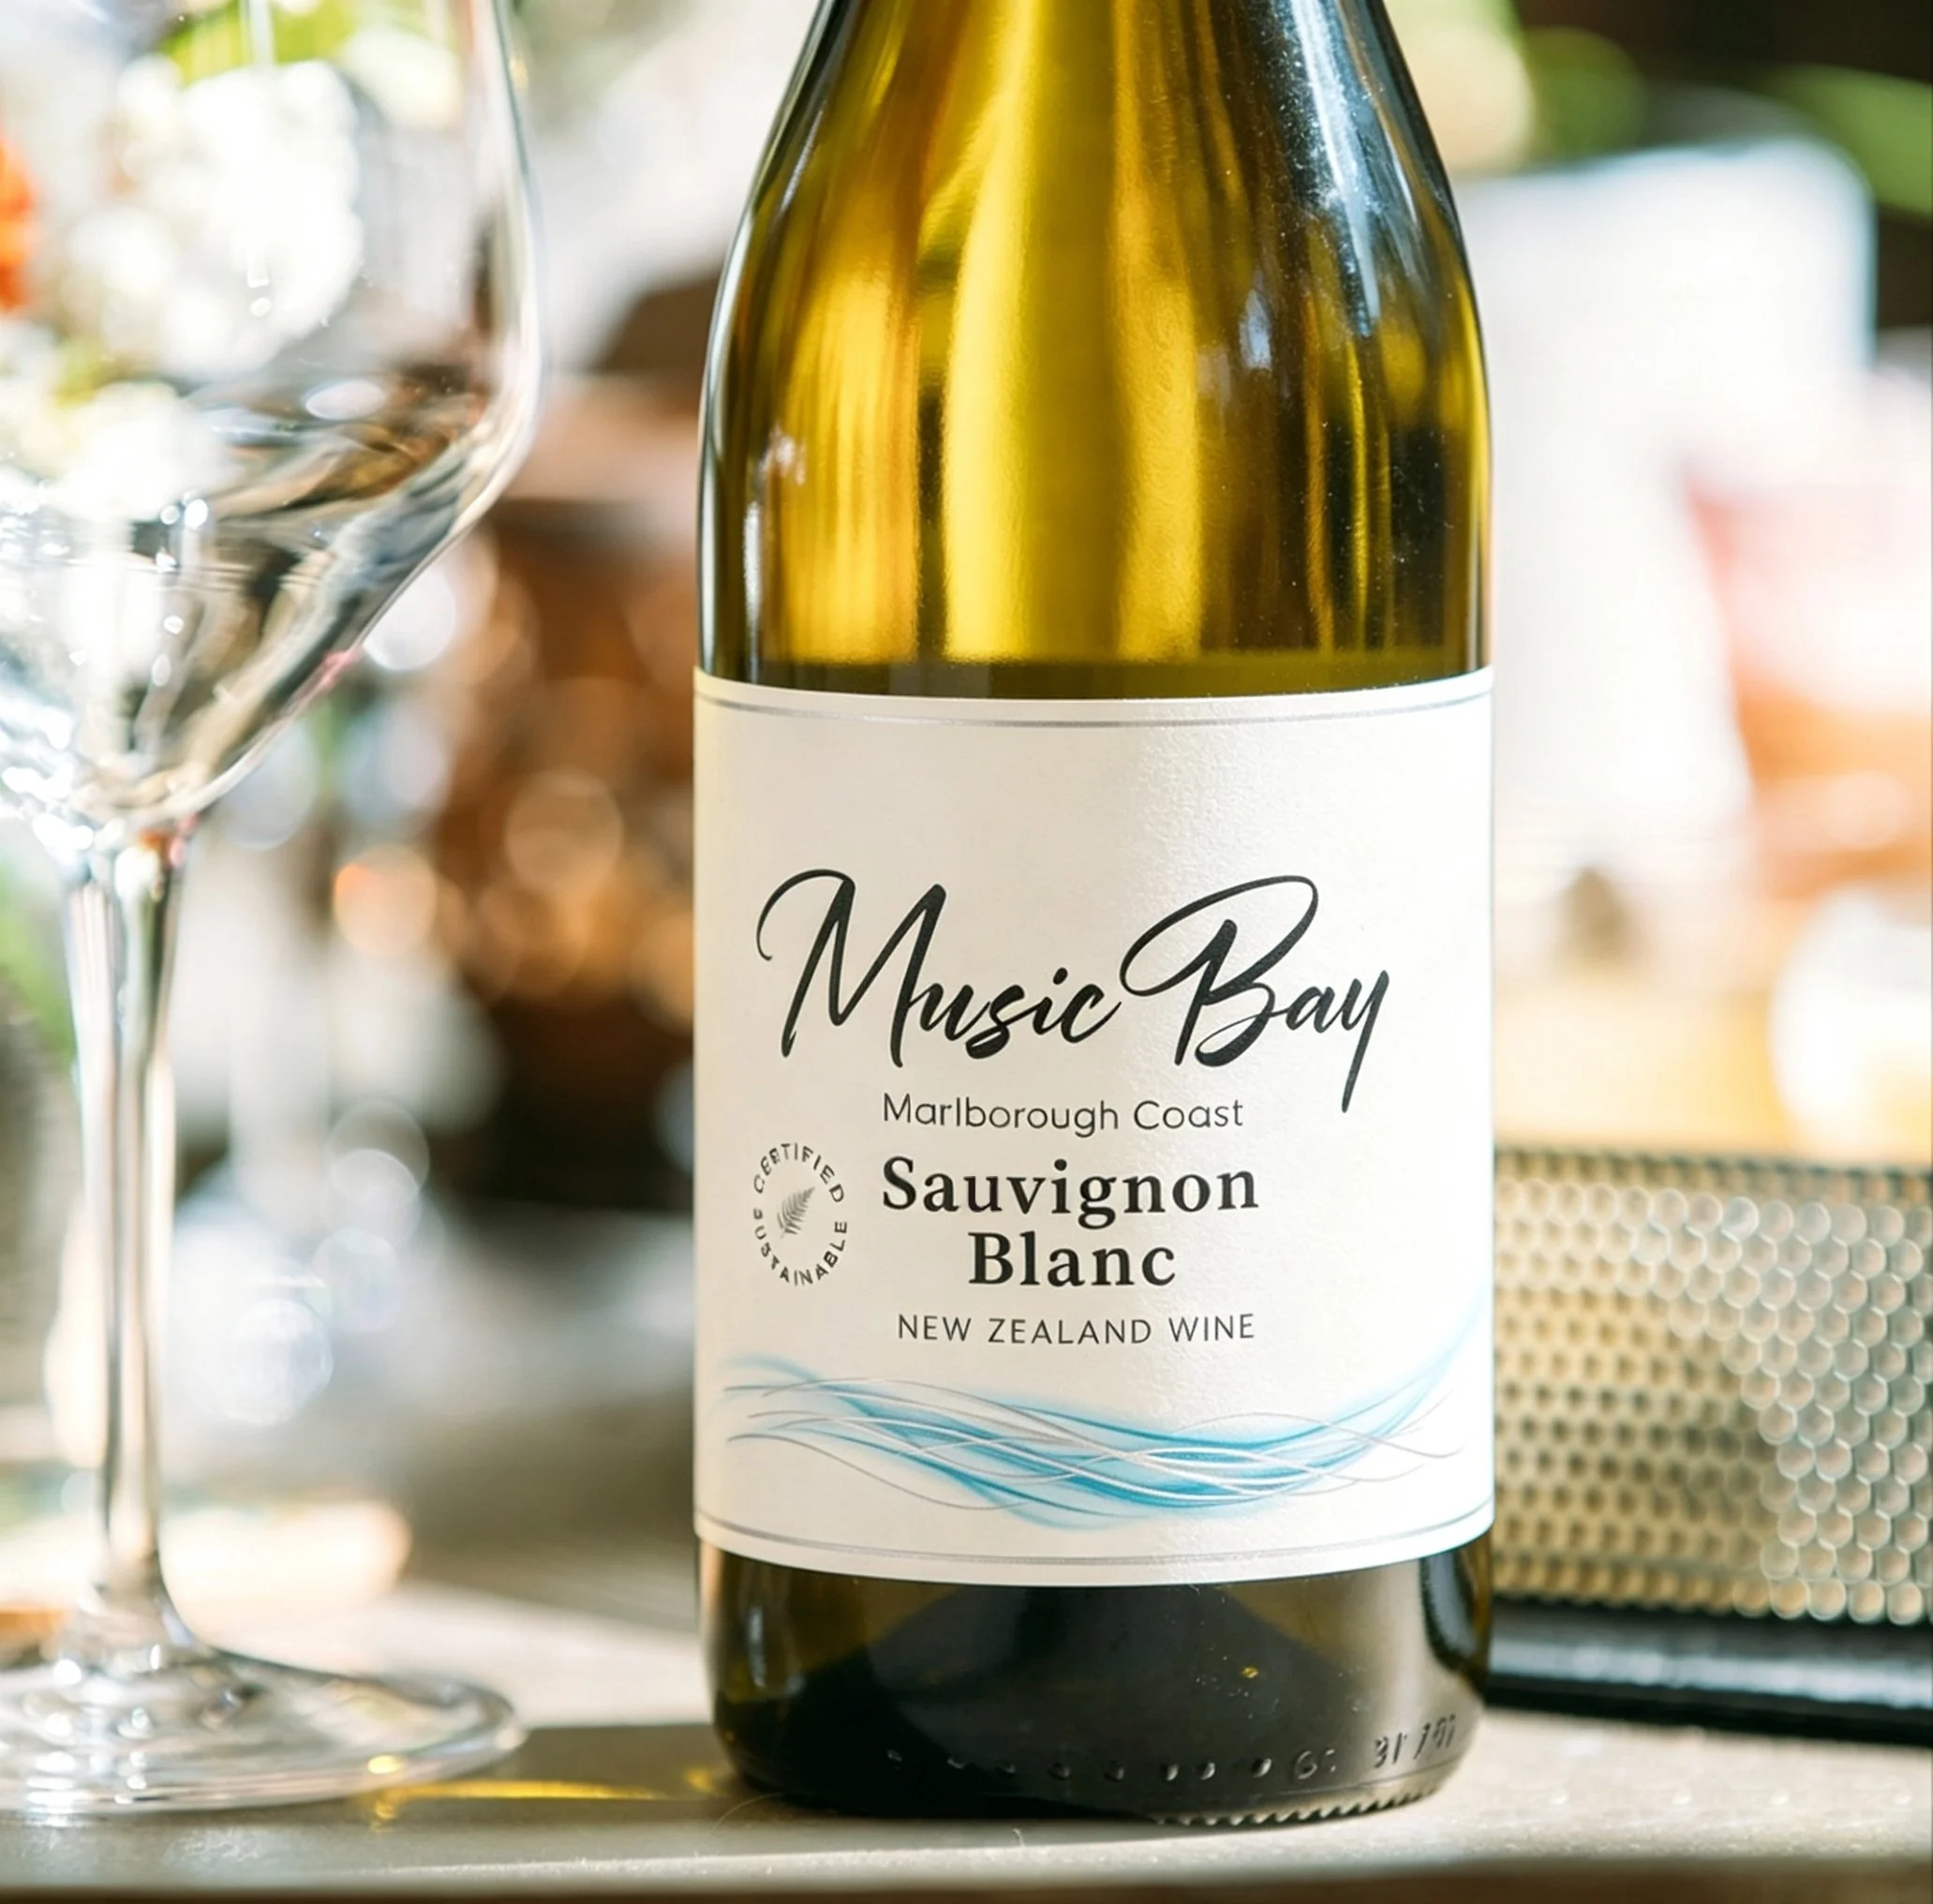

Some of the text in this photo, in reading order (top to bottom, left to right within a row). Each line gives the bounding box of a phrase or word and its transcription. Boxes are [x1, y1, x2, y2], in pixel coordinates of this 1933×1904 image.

[756, 869, 1390, 1113] Music Bay
[885, 1093, 1243, 1138] Marlborough Coast
[752, 1142, 845, 1203] CERTIFIED
[883, 1155, 1259, 1230] Sauvignon
[752, 1207, 848, 1287] SUSTAINABLE
[968, 1230, 1176, 1287] Blanc
[899, 1314, 1255, 1345] NEW ZEALAND WINE
